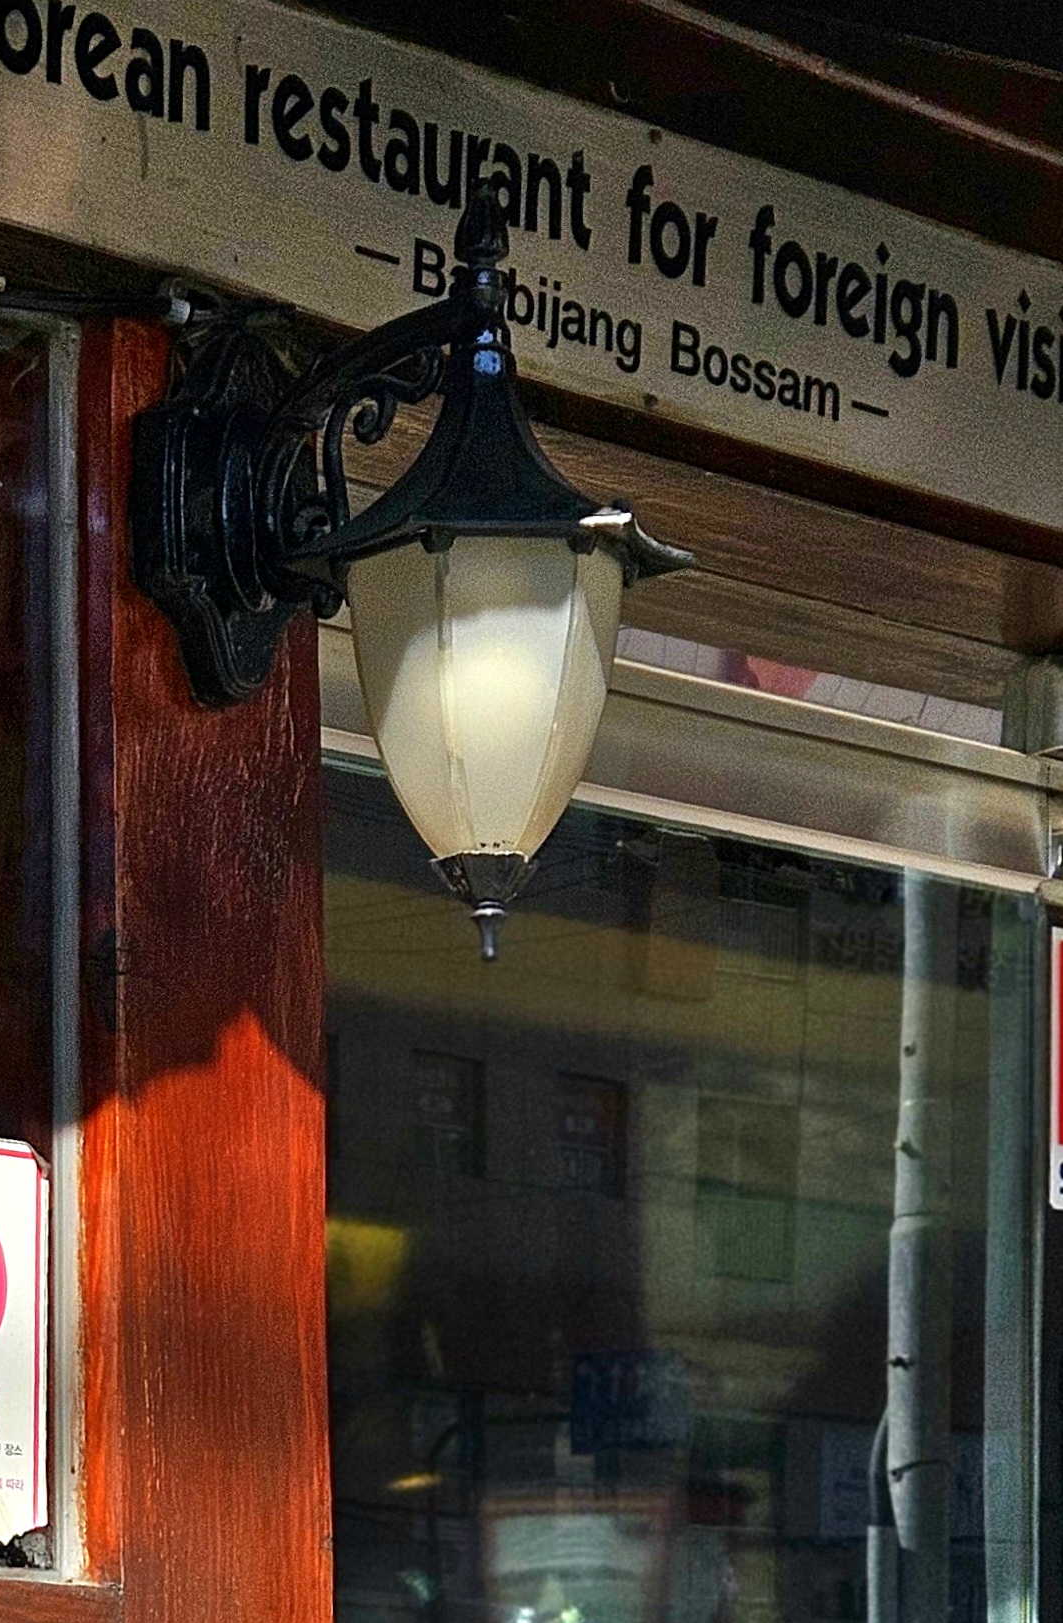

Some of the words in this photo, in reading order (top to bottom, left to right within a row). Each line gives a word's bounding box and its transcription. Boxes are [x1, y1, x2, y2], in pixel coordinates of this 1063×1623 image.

[244, 64, 592, 250] restaurant
[627, 165, 719, 287] for
[749, 204, 959, 378] foreign
[413, 237, 642, 374] Bbijang
[670, 320, 841, 421] Bossam
[6, 1478, 24, 1491] 따라
